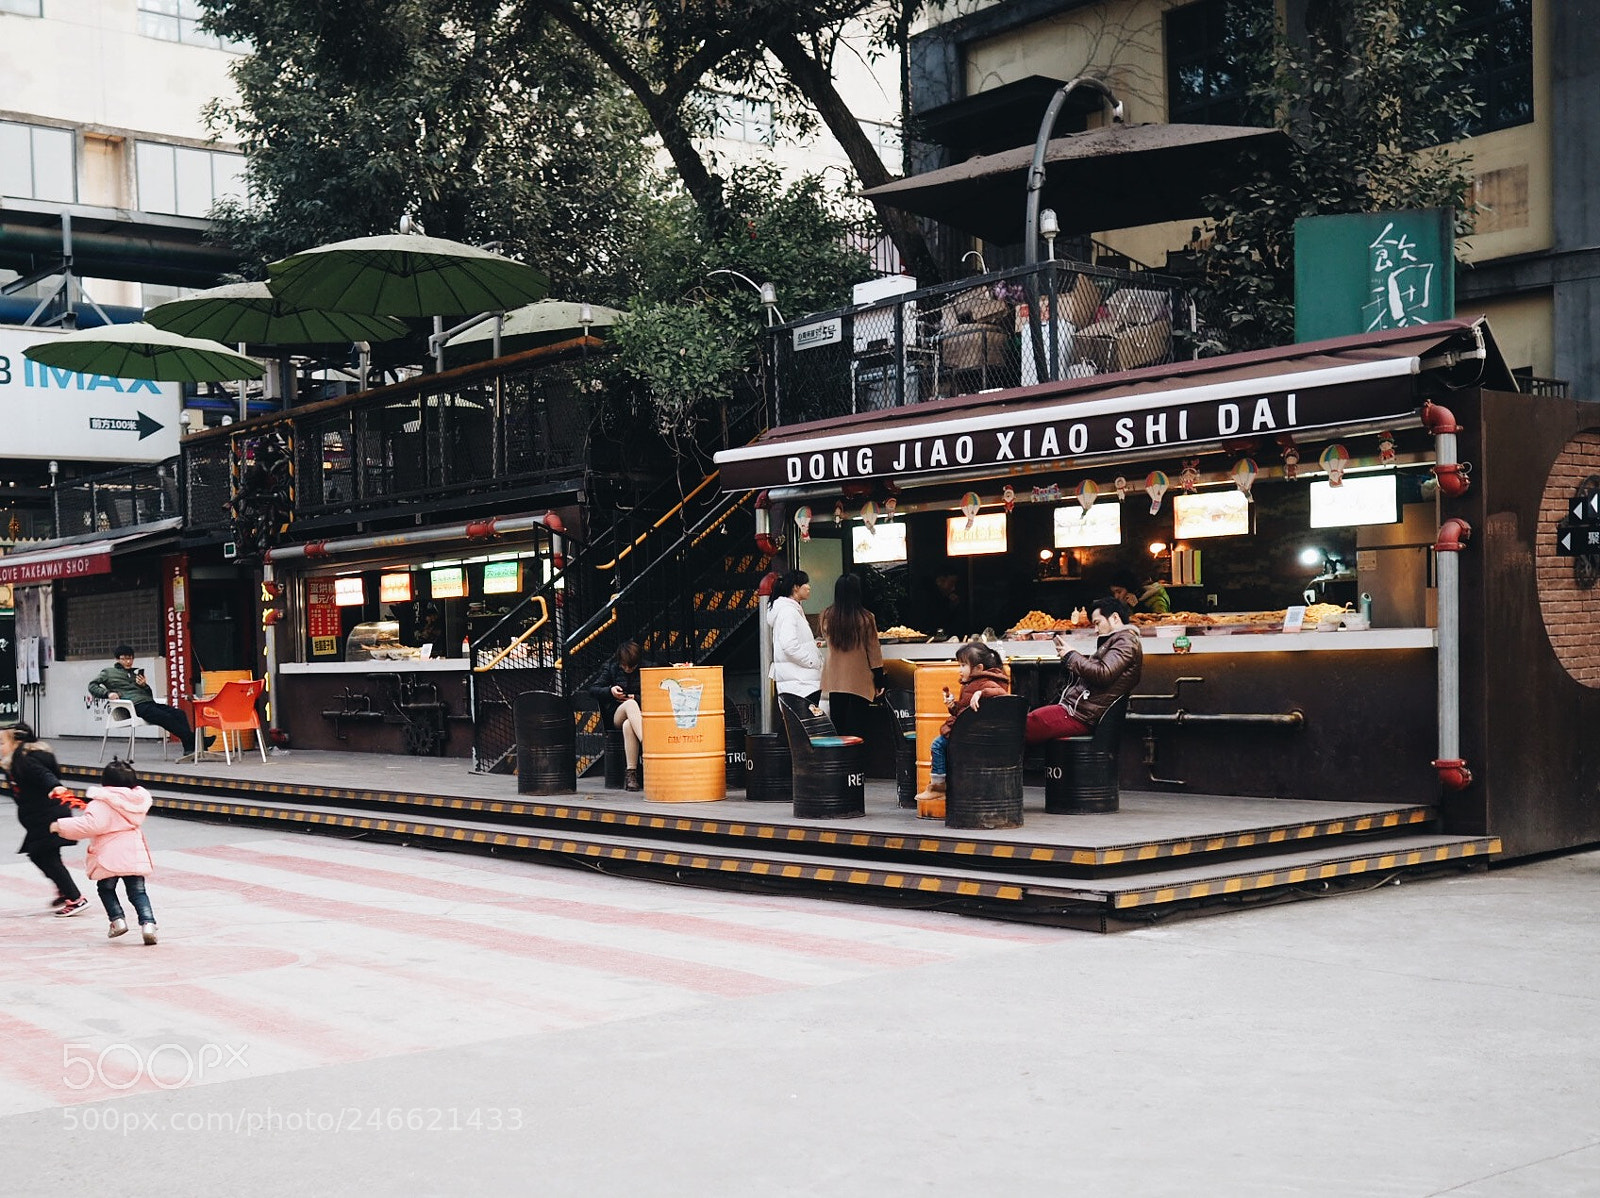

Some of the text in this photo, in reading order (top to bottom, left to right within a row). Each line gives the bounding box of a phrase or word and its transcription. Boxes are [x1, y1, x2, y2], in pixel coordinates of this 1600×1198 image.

[92, 418, 137, 430] 前方100米
[786, 393, 1297, 483] DONG JIAO XIAO SHI DAI
[0, 559, 90, 582] OVE TAKEAWAY SHOP
[171, 681, 179, 709] FOR
[726, 752, 747, 764] TRO
